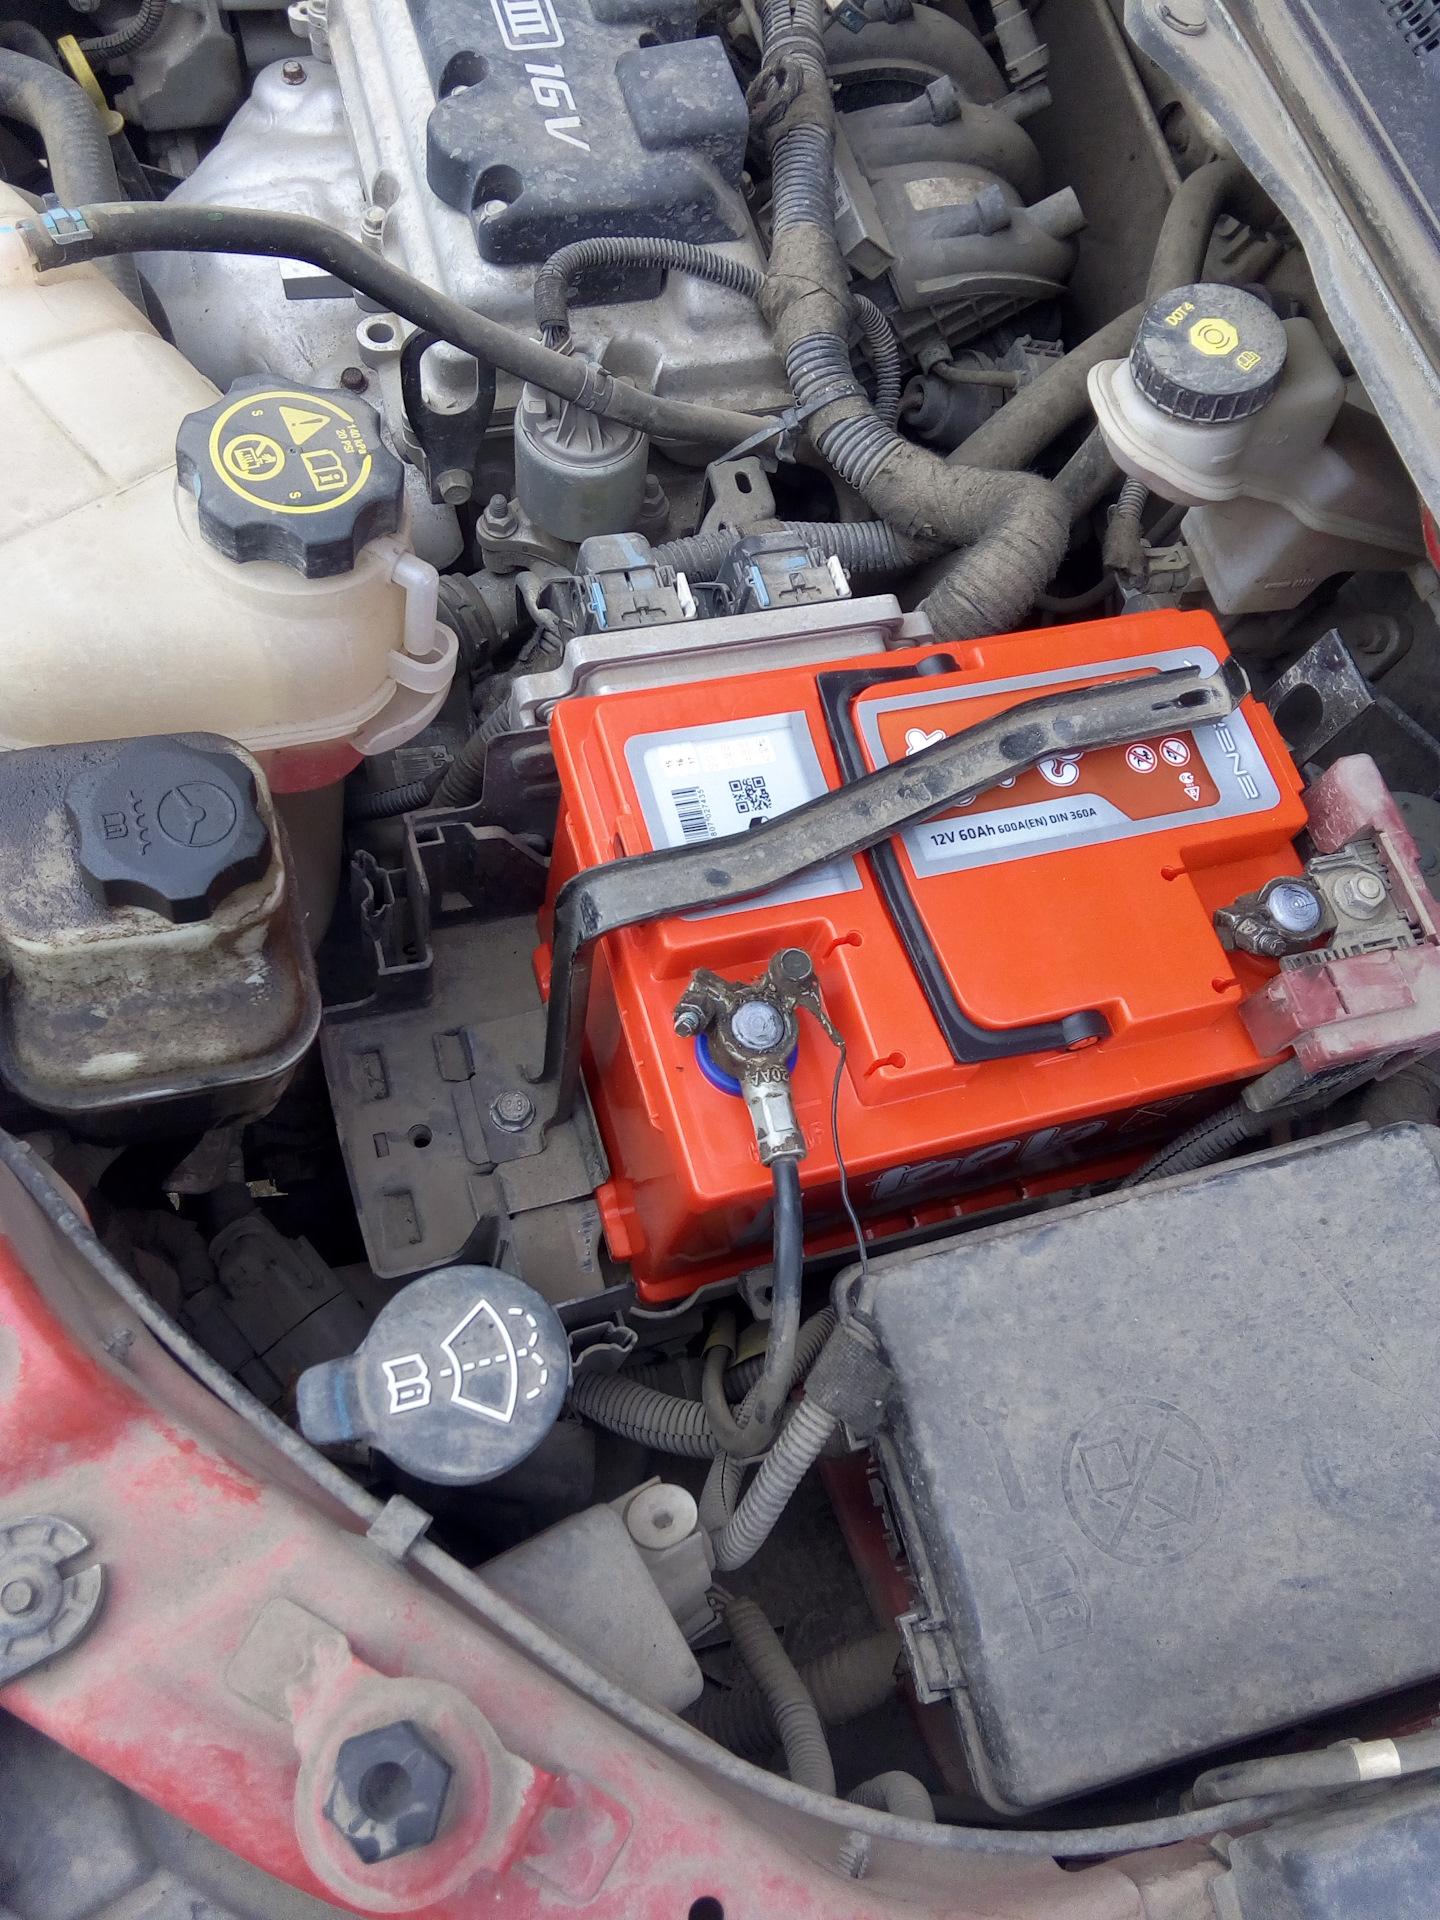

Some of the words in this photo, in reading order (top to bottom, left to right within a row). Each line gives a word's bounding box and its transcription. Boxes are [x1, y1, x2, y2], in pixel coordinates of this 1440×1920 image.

[524, 63, 591, 151] 16V
[1165, 305, 1188, 326] DOT
[1184, 301, 1195, 311] 4
[335, 428, 348, 439] 20
[347, 423, 361, 438] 140
[341, 440, 355, 454] PSI
[353, 438, 367, 454] kPa
[930, 831, 956, 846] 12V
[959, 823, 996, 841] 60Ah
[997, 815, 1048, 834] 600A(EN)
[1049, 811, 1069, 824] DIN
[1069, 807, 1097, 820] 360A
